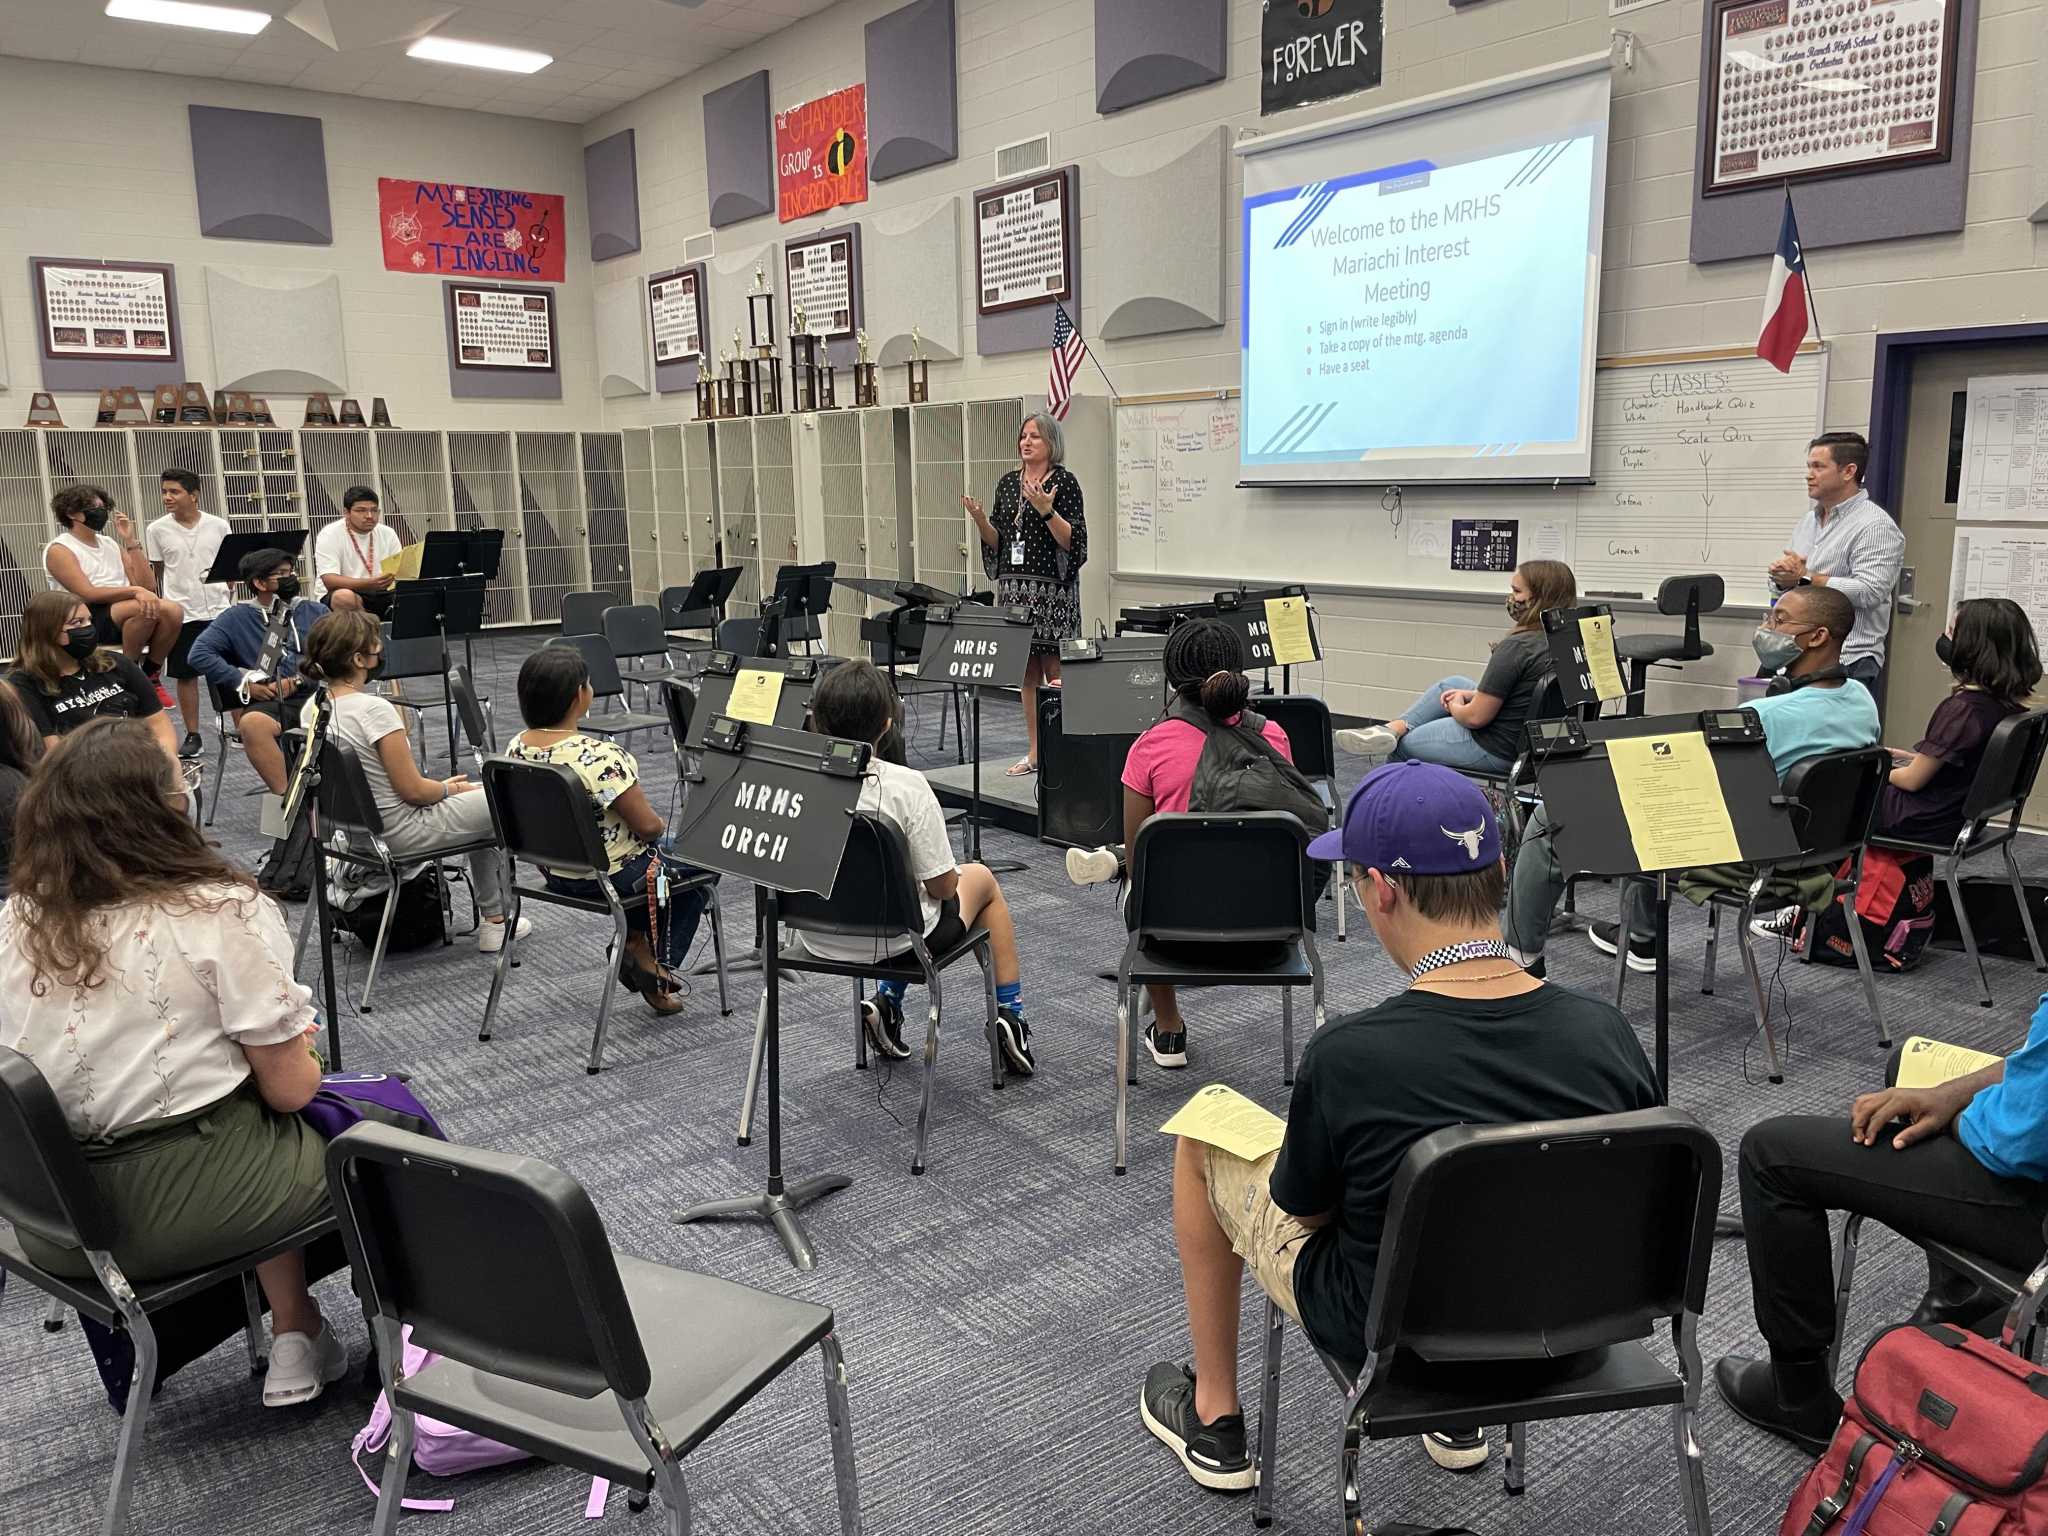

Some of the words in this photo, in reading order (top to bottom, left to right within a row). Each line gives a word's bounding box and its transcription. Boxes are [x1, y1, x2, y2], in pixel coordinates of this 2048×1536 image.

[1273, 20, 1368, 85] FOREVER
[788, 88, 863, 143] CHAMBER
[780, 147, 812, 177] GROUP
[812, 165, 823, 179] IS
[416, 183, 455, 205] MY
[781, 171, 863, 218] INCREDIBLE
[442, 202, 517, 230] SENSES
[1311, 220, 1385, 248] Welcome
[1389, 215, 1406, 236] to
[1411, 208, 1438, 232] the
[1444, 194, 1502, 226] MRHS
[465, 231, 507, 249] ARE
[427, 242, 541, 274] TINGLING
[1333, 246, 1401, 277] Mariachi
[1405, 236, 1471, 266] Interest
[1365, 277, 1432, 304] Meeting
[1319, 321, 1338, 337] Sign
[1339, 318, 1349, 332] in
[1351, 312, 1379, 333] (write
[1381, 309, 1418, 328] legibly)
[1319, 340, 1339, 355] Take
[1340, 342, 1347, 352] a
[1348, 338, 1371, 353] copy
[1372, 333, 1384, 349] of
[1385, 333, 1402, 348] the
[1404, 331, 1427, 347] mtg.
[1429, 326, 1469, 345] agenda
[1319, 363, 1342, 377] Have
[1342, 363, 1349, 374] a
[1350, 358, 1371, 373] seat
[1728, 396, 1757, 409] Quiz
[1677, 428, 1711, 446] Scale
[1723, 426, 1754, 443] Quiz
[953, 639, 998, 656] MRHS
[949, 661, 995, 678] ORCH
[734, 781, 804, 818] MRHS
[721, 823, 789, 863] ORCH
